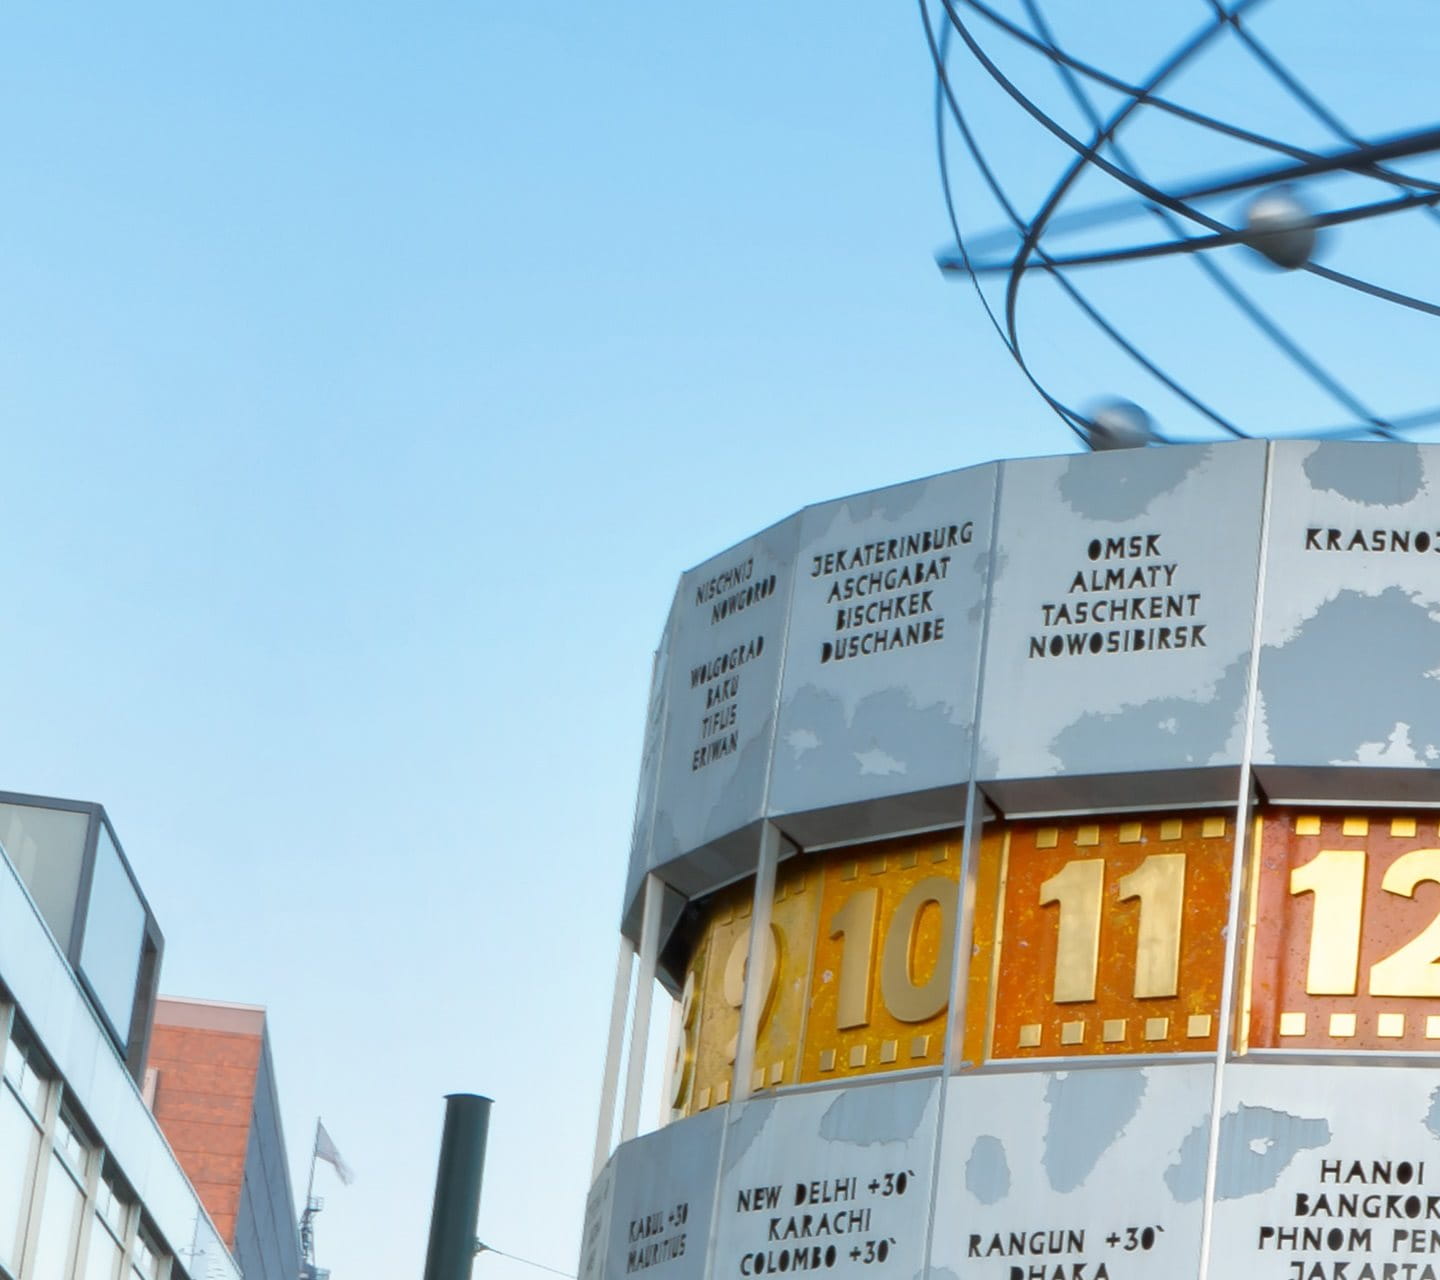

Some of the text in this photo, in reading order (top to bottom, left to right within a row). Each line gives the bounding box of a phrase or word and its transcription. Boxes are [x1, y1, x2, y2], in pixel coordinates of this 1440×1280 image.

[811, 521, 973, 577] JEKATERINBURG
[1087, 534, 1162, 561] OMSK
[695, 558, 754, 607] NISCHNIJ
[828, 556, 951, 604] ASCHGABAT
[1068, 564, 1178, 594] ALMATY
[711, 574, 776, 625] NOWGOROD
[835, 590, 934, 631] BISCHKEK
[1041, 593, 1200, 627] TASCHKENT
[820, 618, 945, 664] DUSCHANBE
[1028, 624, 1207, 659] NOWOSIBIRSK
[690, 636, 764, 689] WOLGOGRAD
[706, 675, 739, 710] BAKU
[702, 703, 738, 740] TIFLIS
[692, 729, 738, 771] ERIWAN
[1039, 853, 1186, 1004] 11
[829, 876, 960, 1031] 10
[1320, 1159, 1425, 1186] HANOI
[737, 1186, 780, 1213] NEW
[796, 1177, 857, 1206] DELHI
[628, 1209, 664, 1244] KABUL
[767, 1209, 871, 1241] KARACHI
[967, 1228, 1085, 1258] RANGUN
[1257, 1226, 1371, 1253] PHNOM
[626, 1233, 687, 1275] MAURITIUS
[740, 1245, 837, 1277] COLOMBO
